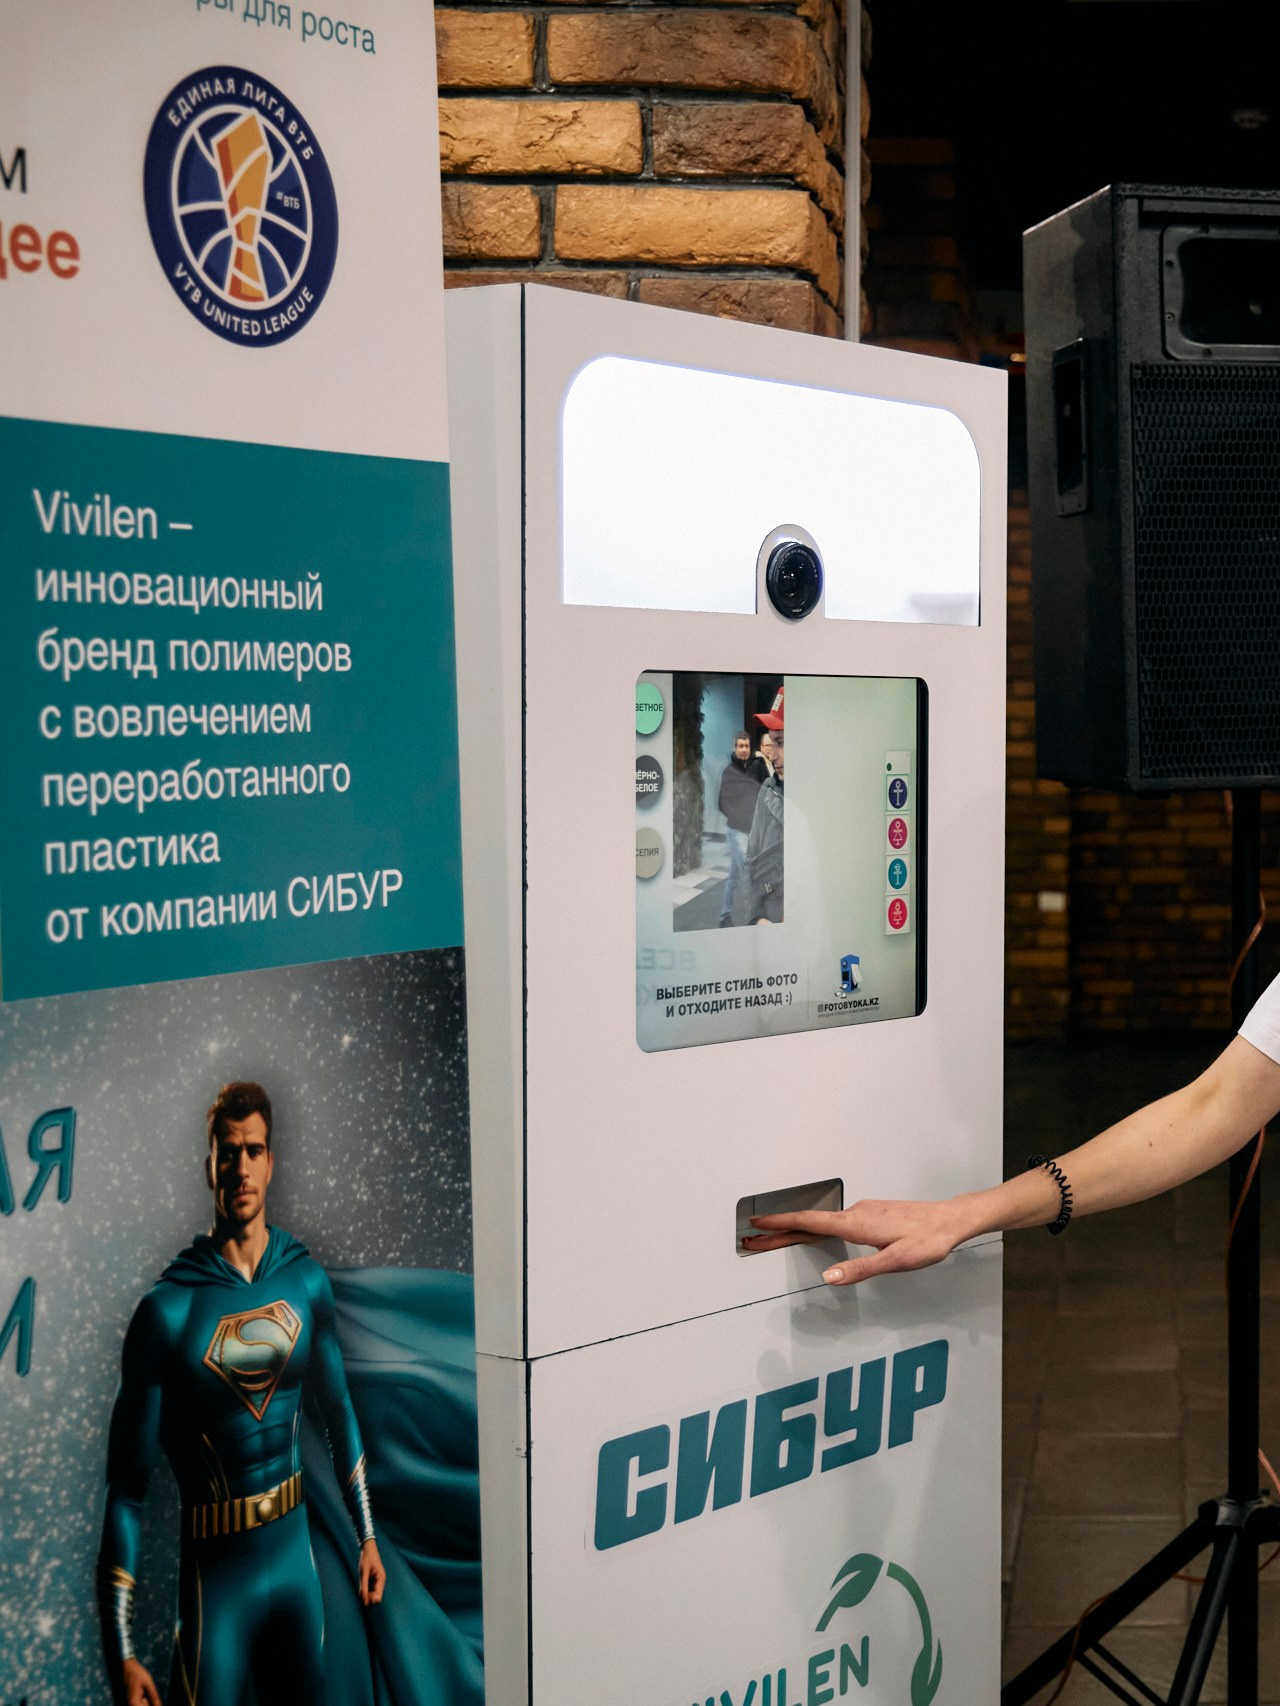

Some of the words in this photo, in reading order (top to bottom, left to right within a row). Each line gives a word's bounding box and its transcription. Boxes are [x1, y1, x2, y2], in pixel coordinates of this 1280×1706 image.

[242, 0, 291, 30] для
[301, 10, 376, 54] роста
[167, 78, 236, 127] ЕДИНАЯ
[242, 82, 286, 123] ЛИГА
[287, 120, 314, 160] ВТБ
[283, 195, 301, 210] ВТБ
[0, 221, 80, 280] ее
[174, 263, 203, 303] VTB
[203, 299, 261, 336] UNITED
[263, 286, 314, 335] LEAGUE
[32, 488, 158, 540] Vivilen
[36, 569, 323, 615] инновационный
[37, 626, 158, 682] бренд
[169, 639, 352, 682] полимеров
[40, 705, 62, 740] с
[74, 703, 311, 738] вовлечением
[42, 758, 351, 816] переработанного
[636, 769, 660, 780] ЁРНО-
[45, 831, 221, 875] пластика
[47, 907, 90, 943] от
[102, 889, 277, 937] компании
[287, 868, 403, 917] СИБУР
[656, 981, 722, 1001] ВЫБЕРИТЕ
[724, 977, 763, 992] СТИЛЬ
[766, 972, 798, 987] ФОТО
[665, 1004, 675, 1018] И
[678, 997, 742, 1017] ОТХОДИТЕ
[744, 991, 783, 1008] НАЗАД
[824, 997, 880, 1012] FOTOBYDKA.KZ
[594, 1338, 950, 1552] СИБУР
